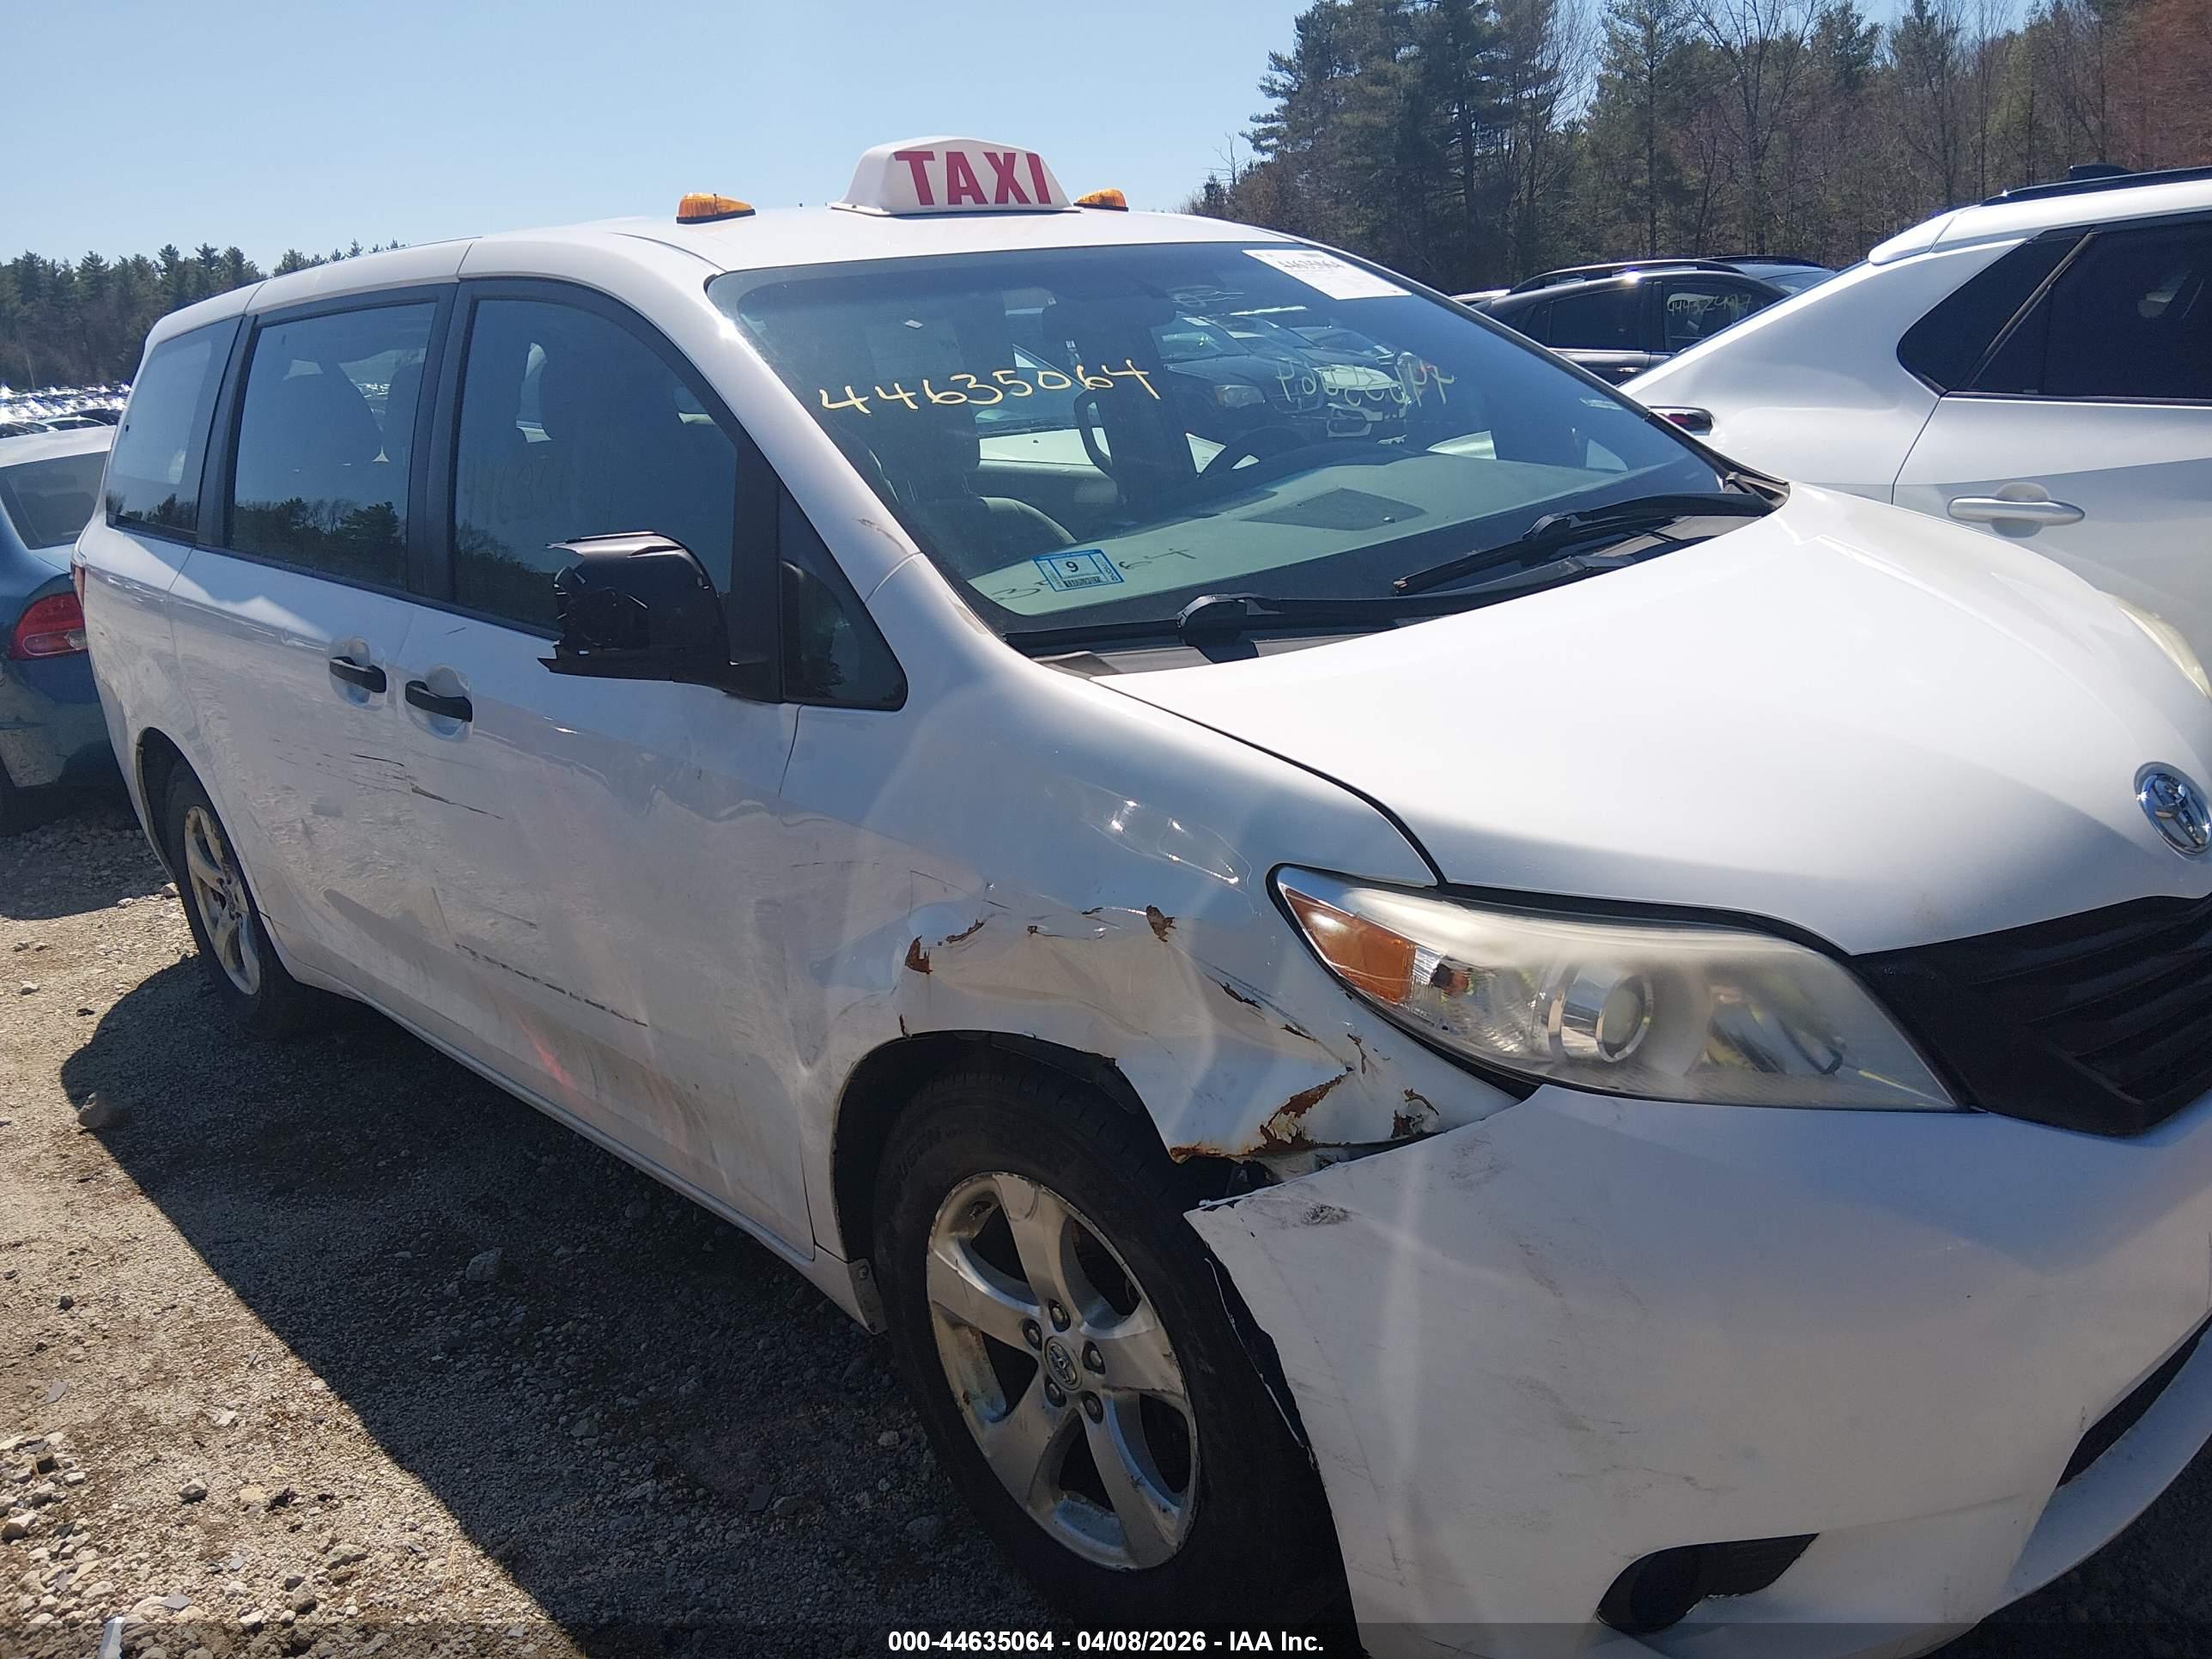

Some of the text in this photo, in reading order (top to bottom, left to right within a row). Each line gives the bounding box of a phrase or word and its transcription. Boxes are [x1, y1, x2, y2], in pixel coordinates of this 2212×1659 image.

[893, 150, 1052, 205] TAXI
[819, 358, 1161, 414] 44635064
[1066, 561, 1079, 573] 9
